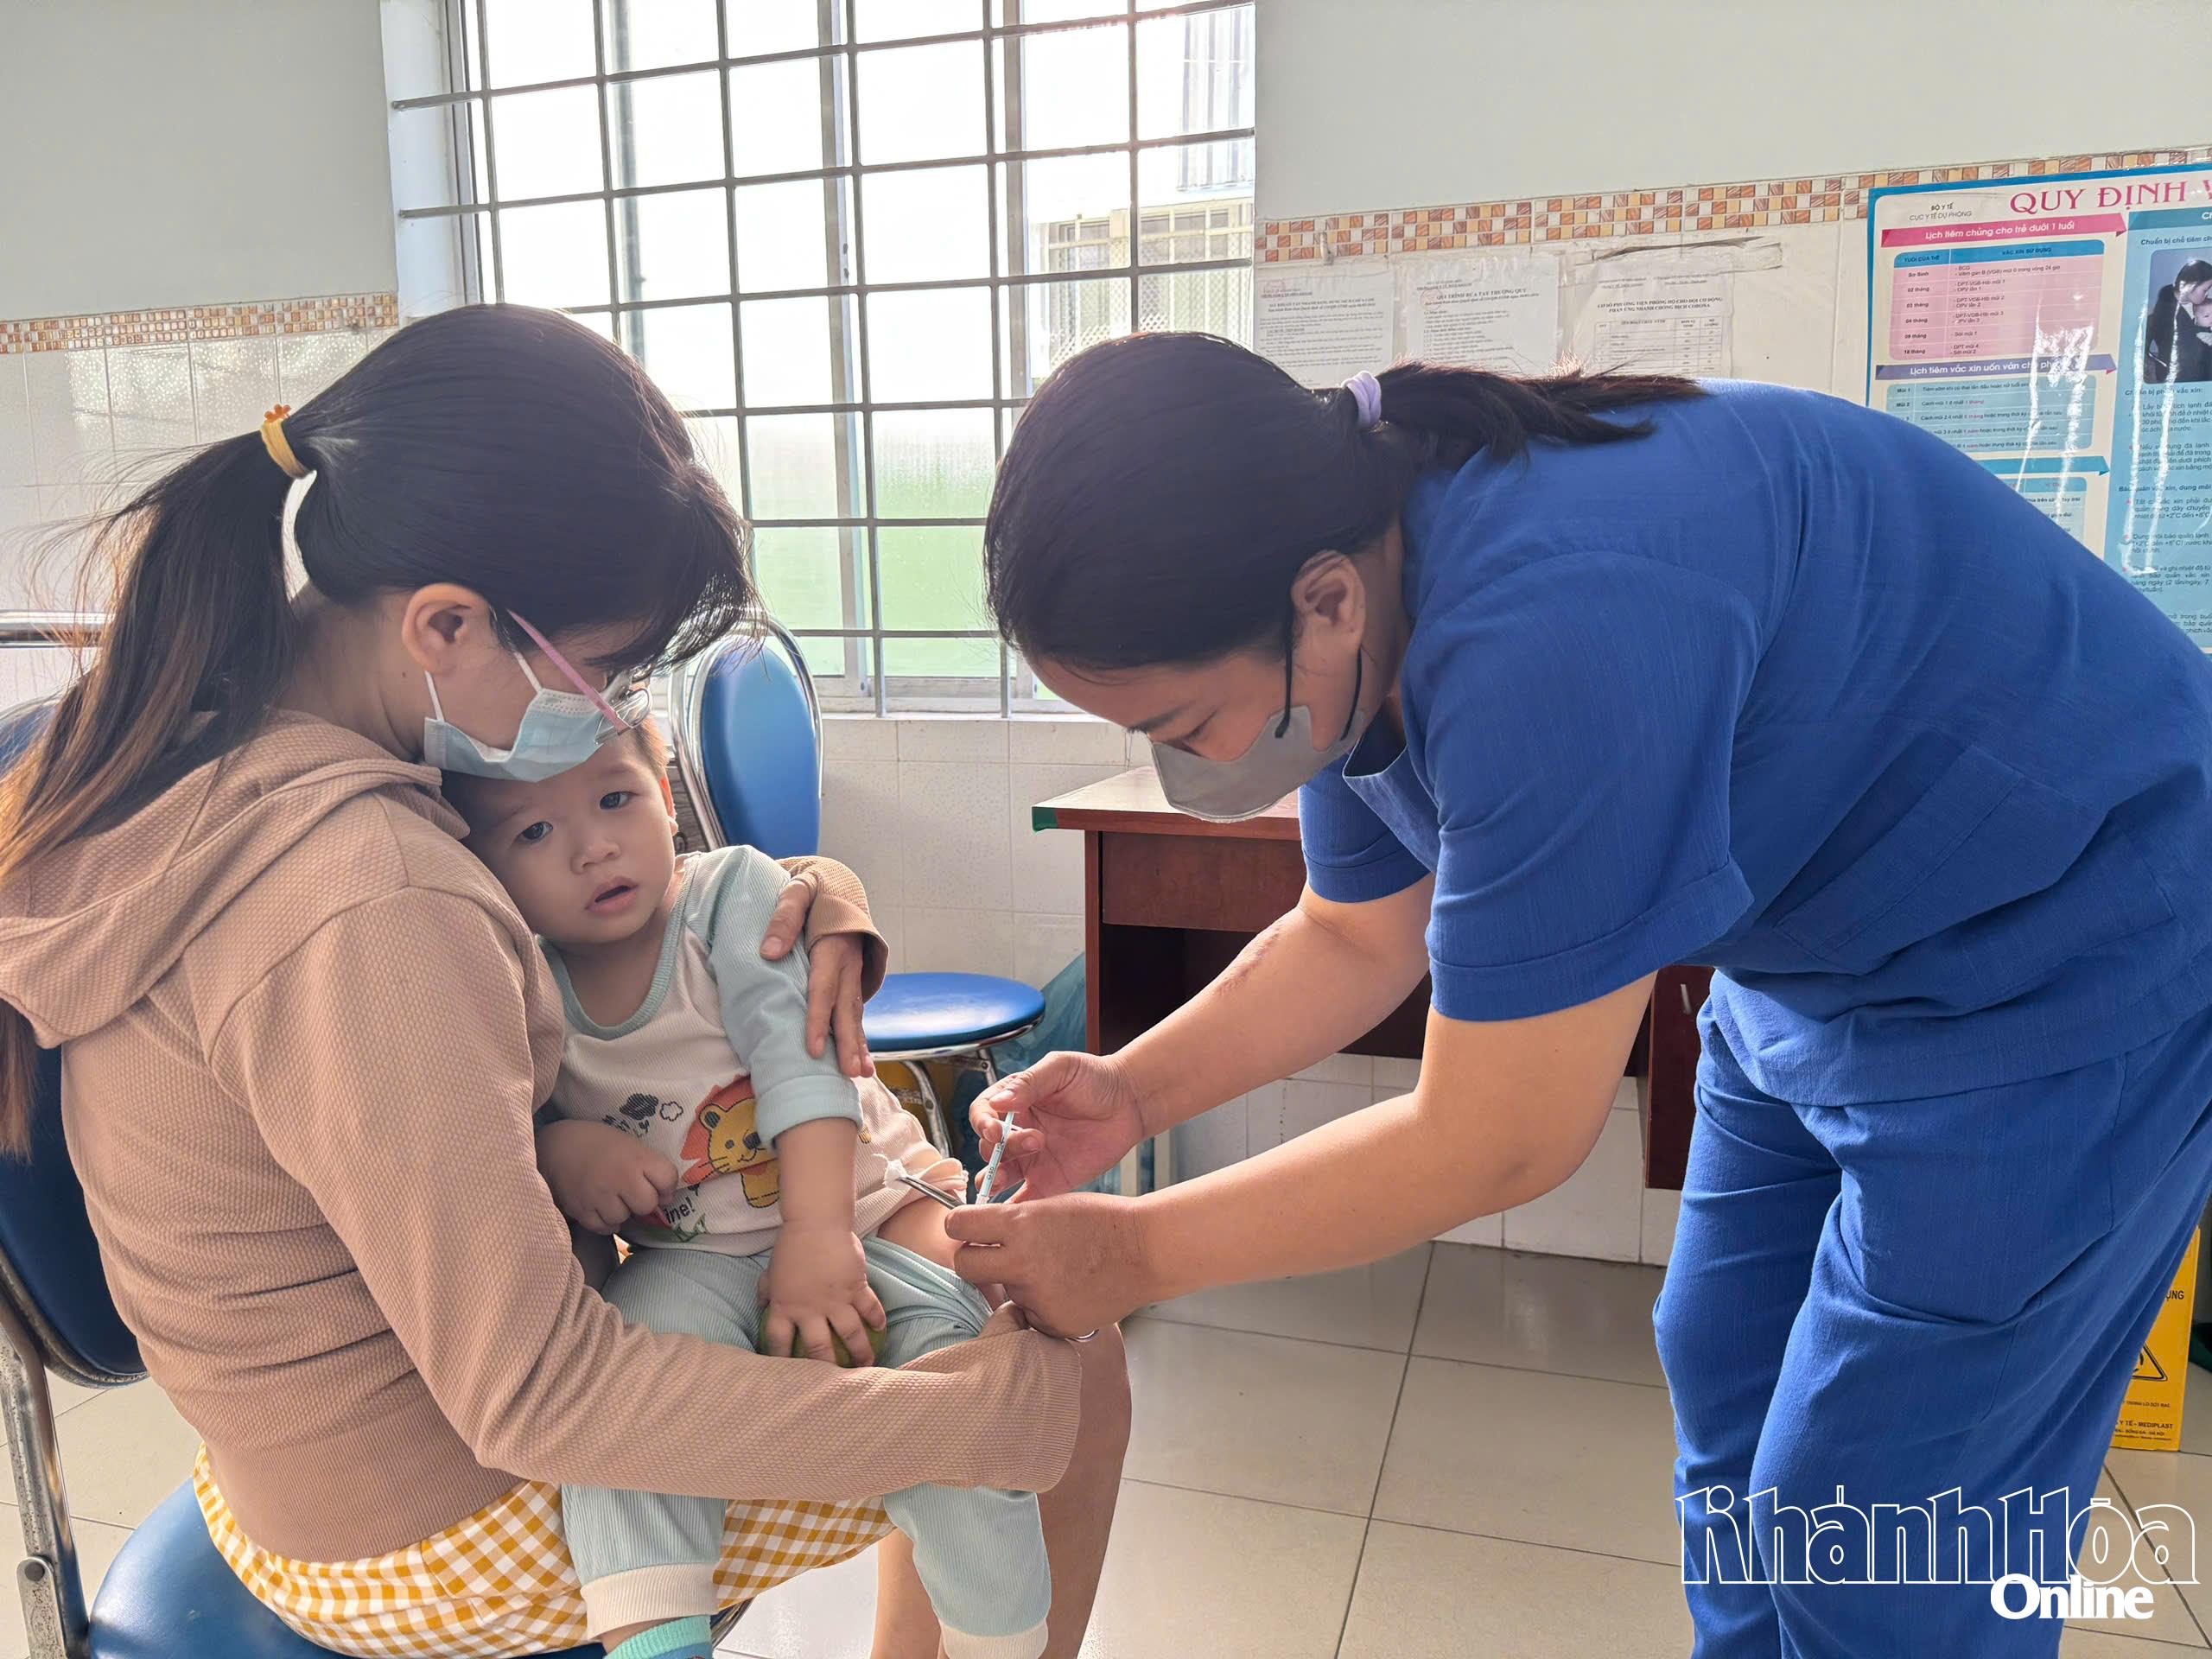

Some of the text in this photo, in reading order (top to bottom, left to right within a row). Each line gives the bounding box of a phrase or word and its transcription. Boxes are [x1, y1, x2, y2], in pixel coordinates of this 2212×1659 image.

[2010, 188, 2087, 214] QUY
[2097, 181, 2187, 210] ĐỊNH
[1995, 226, 2013, 235] cho
[1910, 367, 1928, 376] Lịch
[1929, 365, 1948, 374] tiêm
[1968, 364, 1981, 372] xin
[1983, 362, 2000, 372] uốn
[2021, 360, 2035, 369] ch
